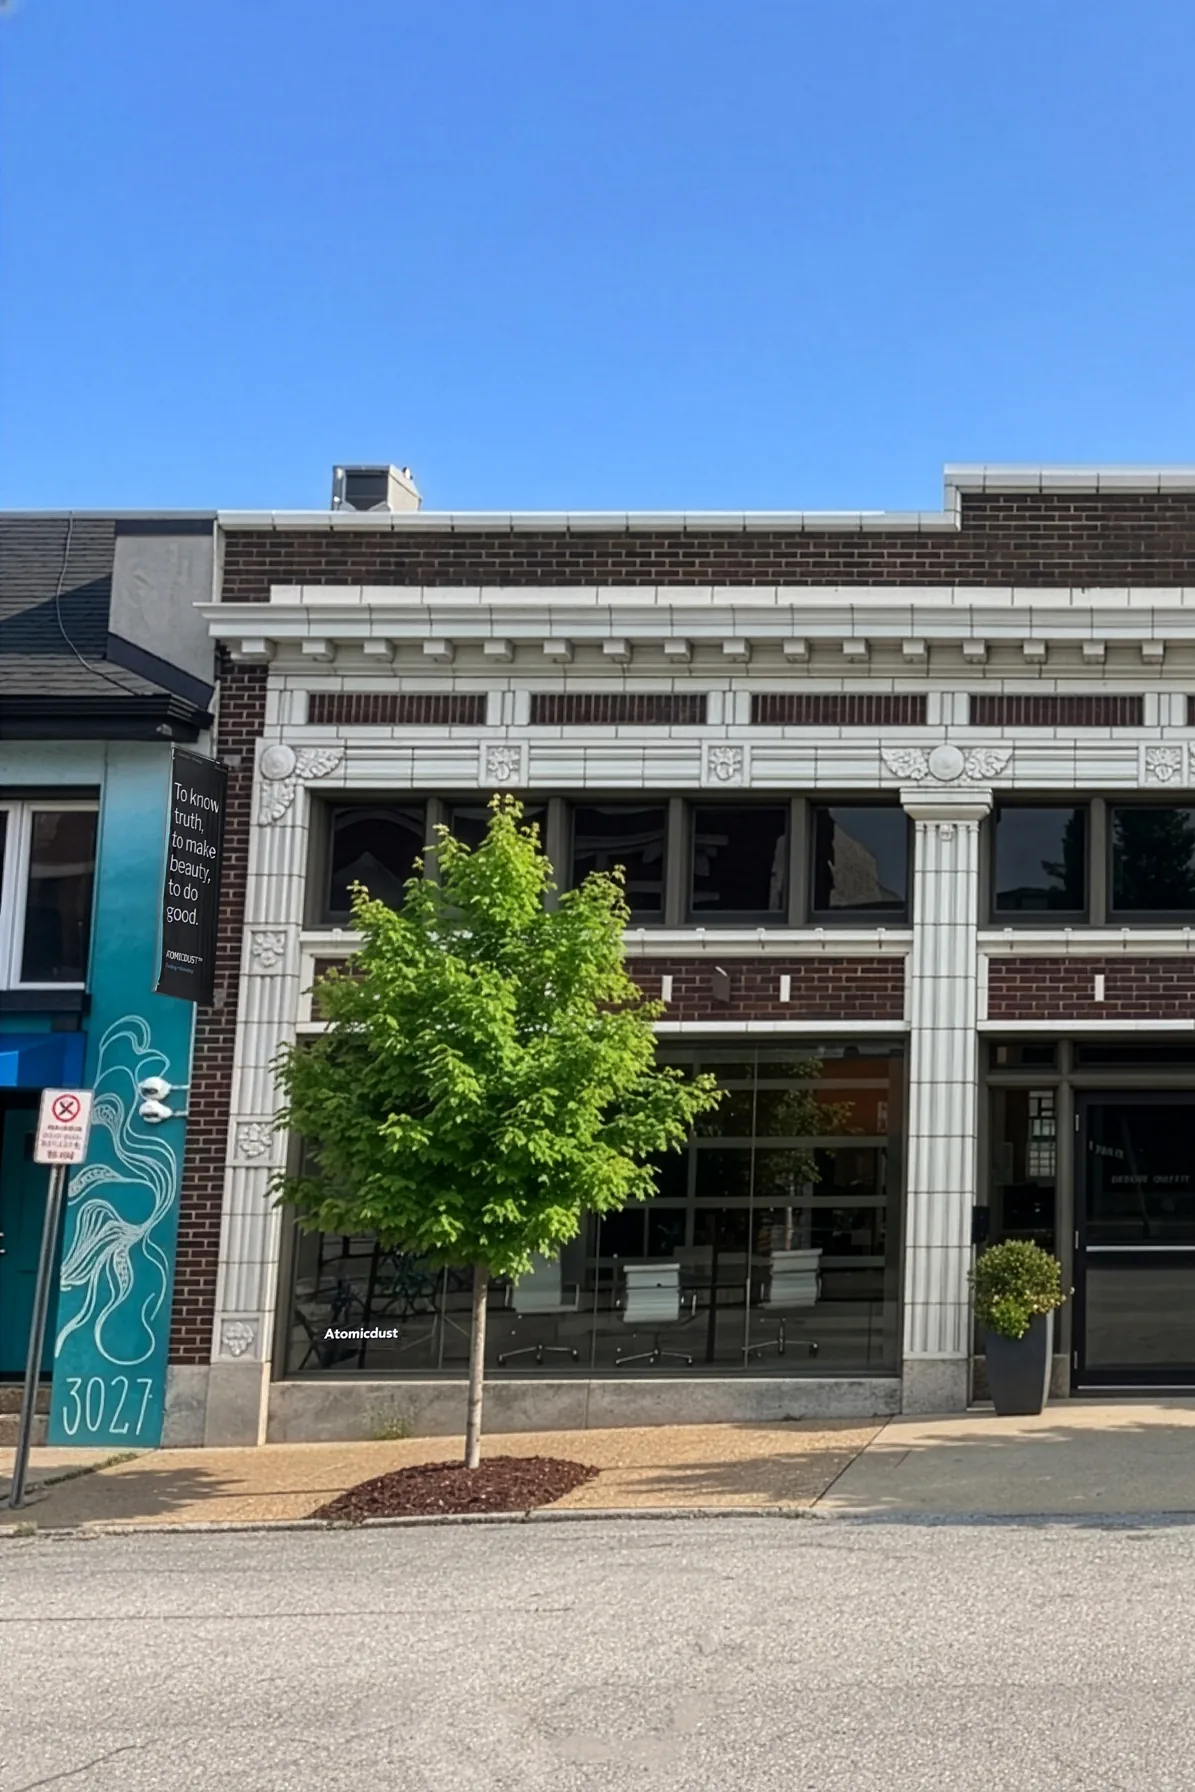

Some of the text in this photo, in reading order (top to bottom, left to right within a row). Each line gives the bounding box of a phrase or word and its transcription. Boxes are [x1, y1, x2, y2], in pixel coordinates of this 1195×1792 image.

[174, 782, 219, 813] To know
[174, 807, 204, 834] truth,
[172, 831, 217, 859] to make
[169, 854, 211, 884] beauty,
[168, 879, 199, 901] to do
[166, 906, 199, 926] good.
[323, 1326, 399, 1340] Atomicdust
[62, 1375, 152, 1436] 3027
